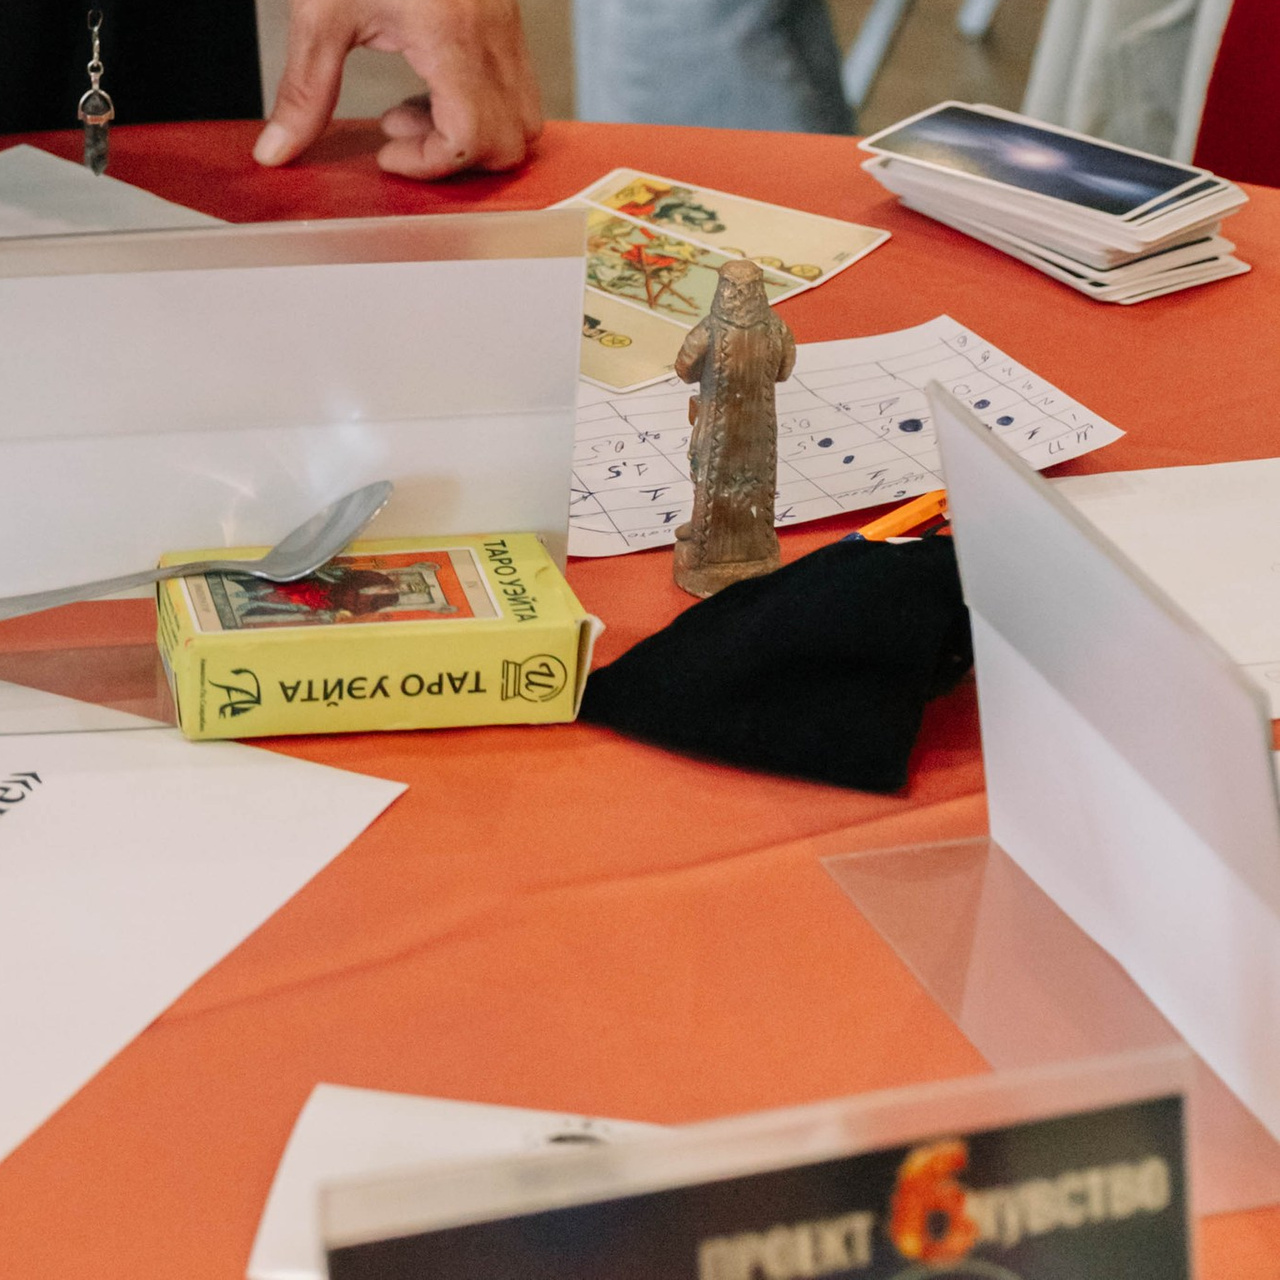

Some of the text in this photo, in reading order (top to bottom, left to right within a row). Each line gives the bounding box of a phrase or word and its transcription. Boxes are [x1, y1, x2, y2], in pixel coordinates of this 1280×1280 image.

[483, 539, 539, 623] ТАРО УЭЙТА
[277, 669, 488, 708] ТАРО УЭЙТА
